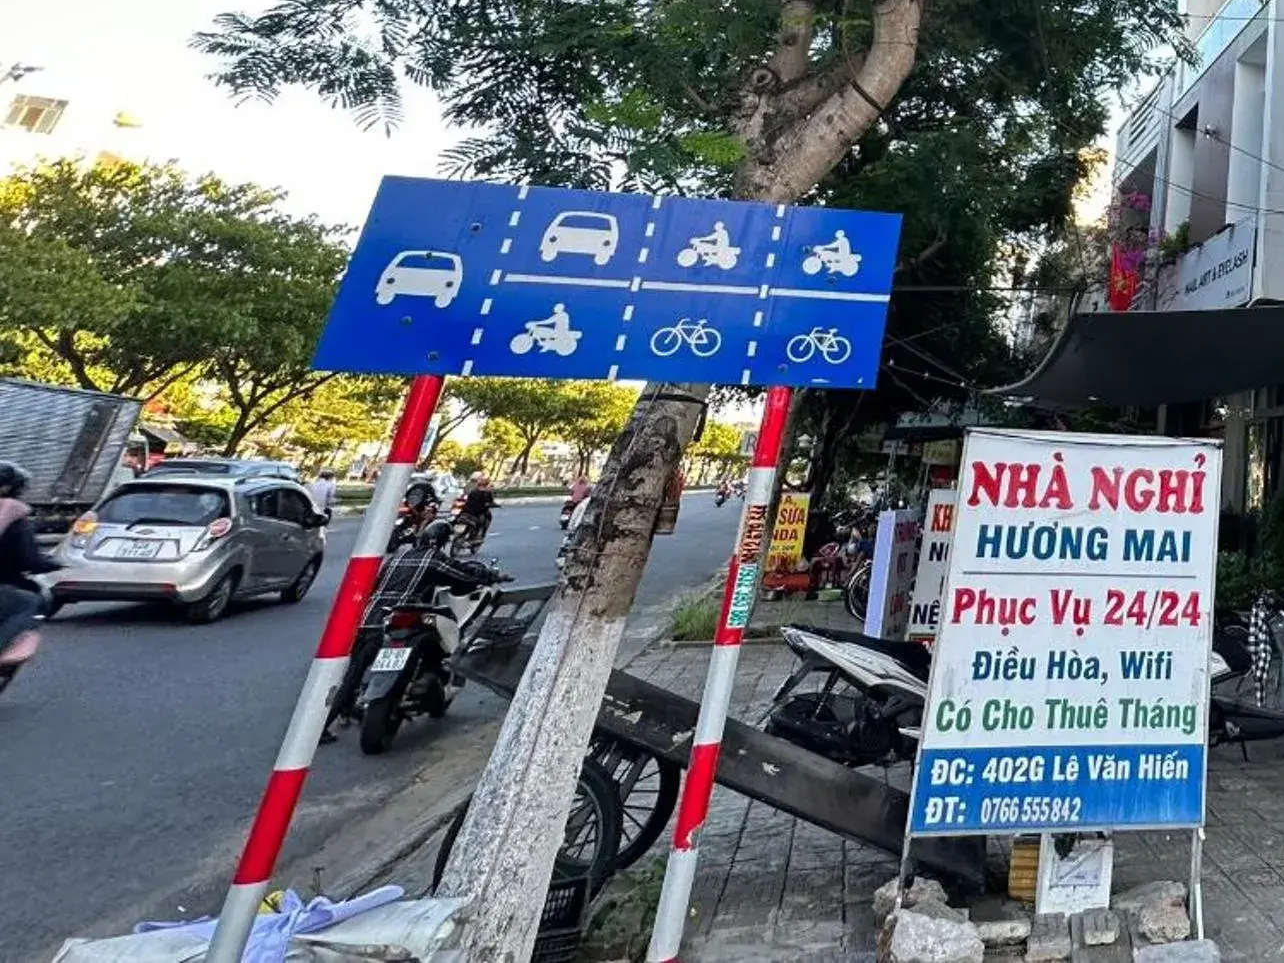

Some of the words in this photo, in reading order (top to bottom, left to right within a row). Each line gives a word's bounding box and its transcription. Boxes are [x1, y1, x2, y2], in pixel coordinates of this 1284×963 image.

[967, 451, 1073, 510] NHÀ
[1088, 452, 1207, 514] NGHỈ
[975, 520, 1108, 561] HƯƠNG
[1122, 528, 1192, 563] MAI
[951, 587, 1037, 636] Phục
[1049, 588, 1092, 636] Vụ
[1103, 589, 1201, 630] 24/24
[971, 645, 1037, 681] Điều
[1046, 649, 1109, 685] Hòa,
[1119, 650, 1173, 680] Wifi
[935, 698, 972, 732] Có
[982, 697, 1035, 732] Cho
[1044, 696, 1109, 730] Thuê
[1118, 696, 1197, 735] Tháng
[930, 757, 974, 785] ĐC:
[981, 755, 1045, 784] 402G
[1052, 754, 1080, 782] Lê
[1087, 754, 1130, 782] Văn
[1137, 749, 1189, 781] Hiến
[924, 796, 967, 824] ĐT:
